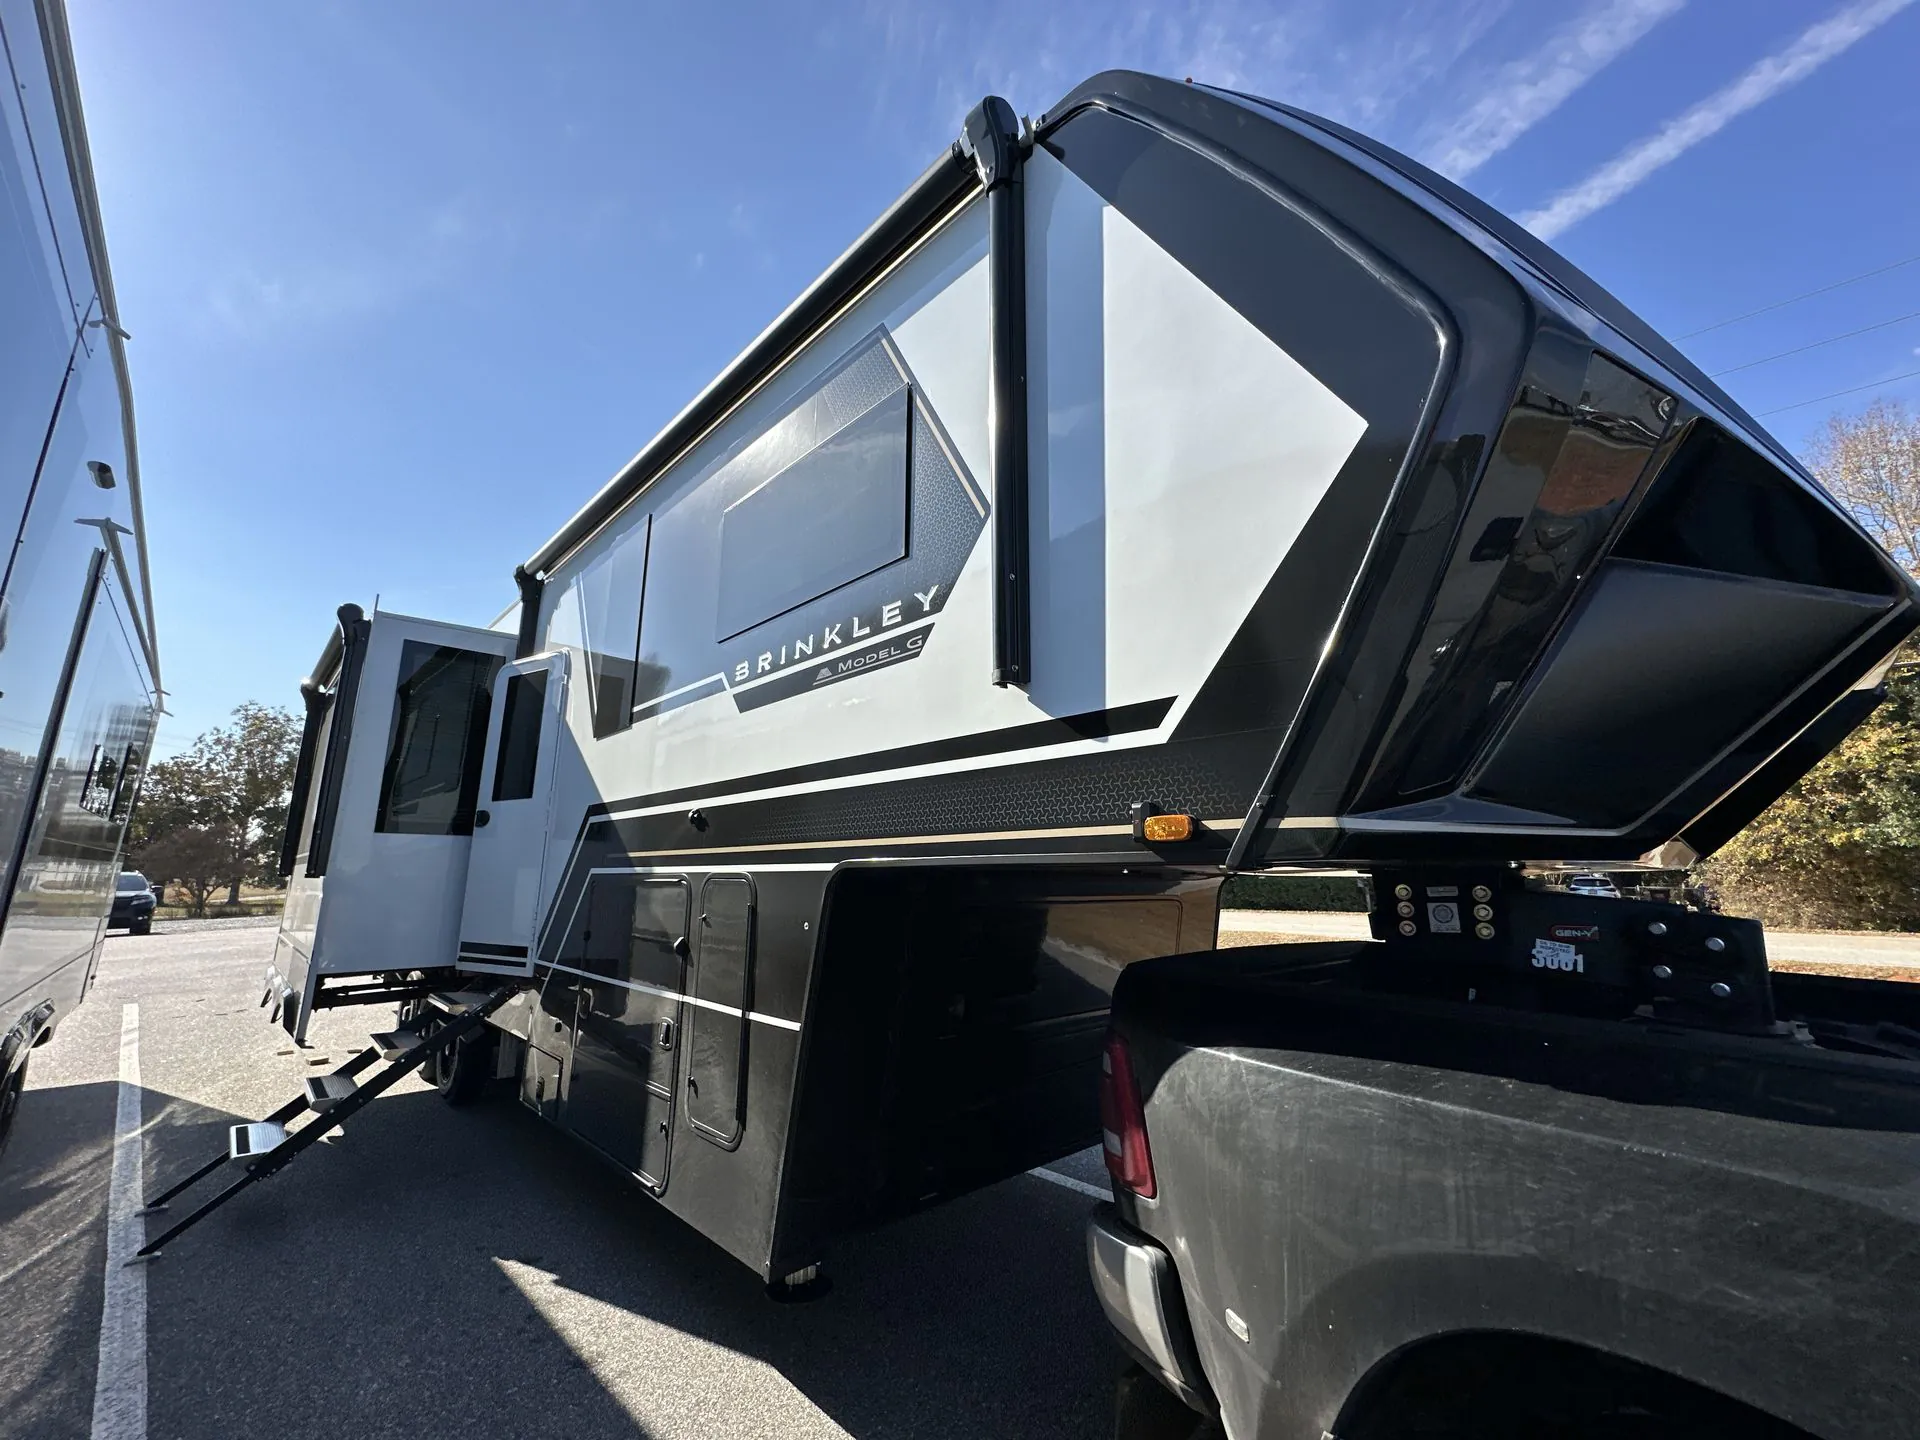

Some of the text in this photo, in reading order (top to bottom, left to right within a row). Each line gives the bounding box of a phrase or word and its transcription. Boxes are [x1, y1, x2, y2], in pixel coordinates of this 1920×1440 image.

[735, 584, 939, 682] BRINKLEY
[838, 635, 923, 673] MODEL G
